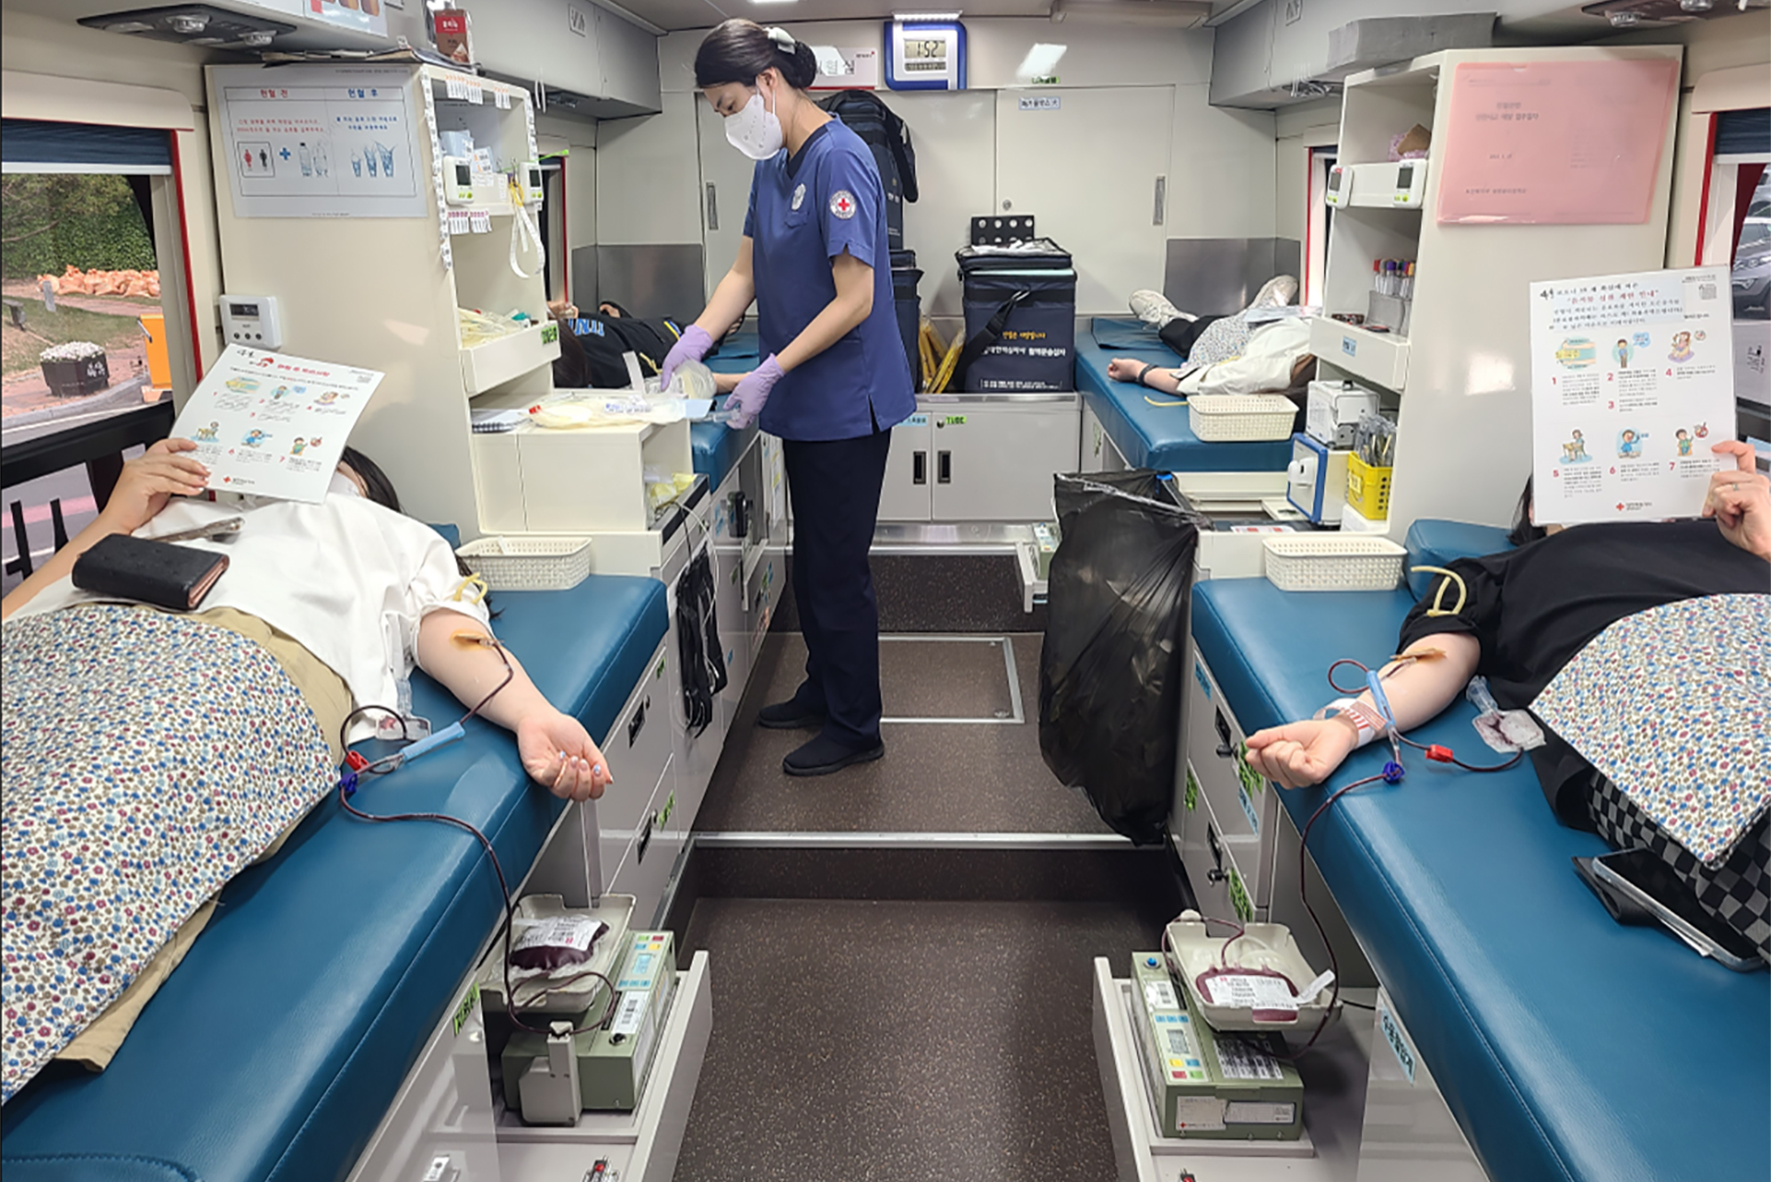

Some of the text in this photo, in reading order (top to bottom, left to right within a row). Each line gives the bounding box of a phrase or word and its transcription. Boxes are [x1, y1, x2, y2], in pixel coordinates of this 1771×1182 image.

[917, 41, 939, 58] 1:52
[260, 89, 276, 98] 헌혈
[348, 89, 365, 98] 헌혈
